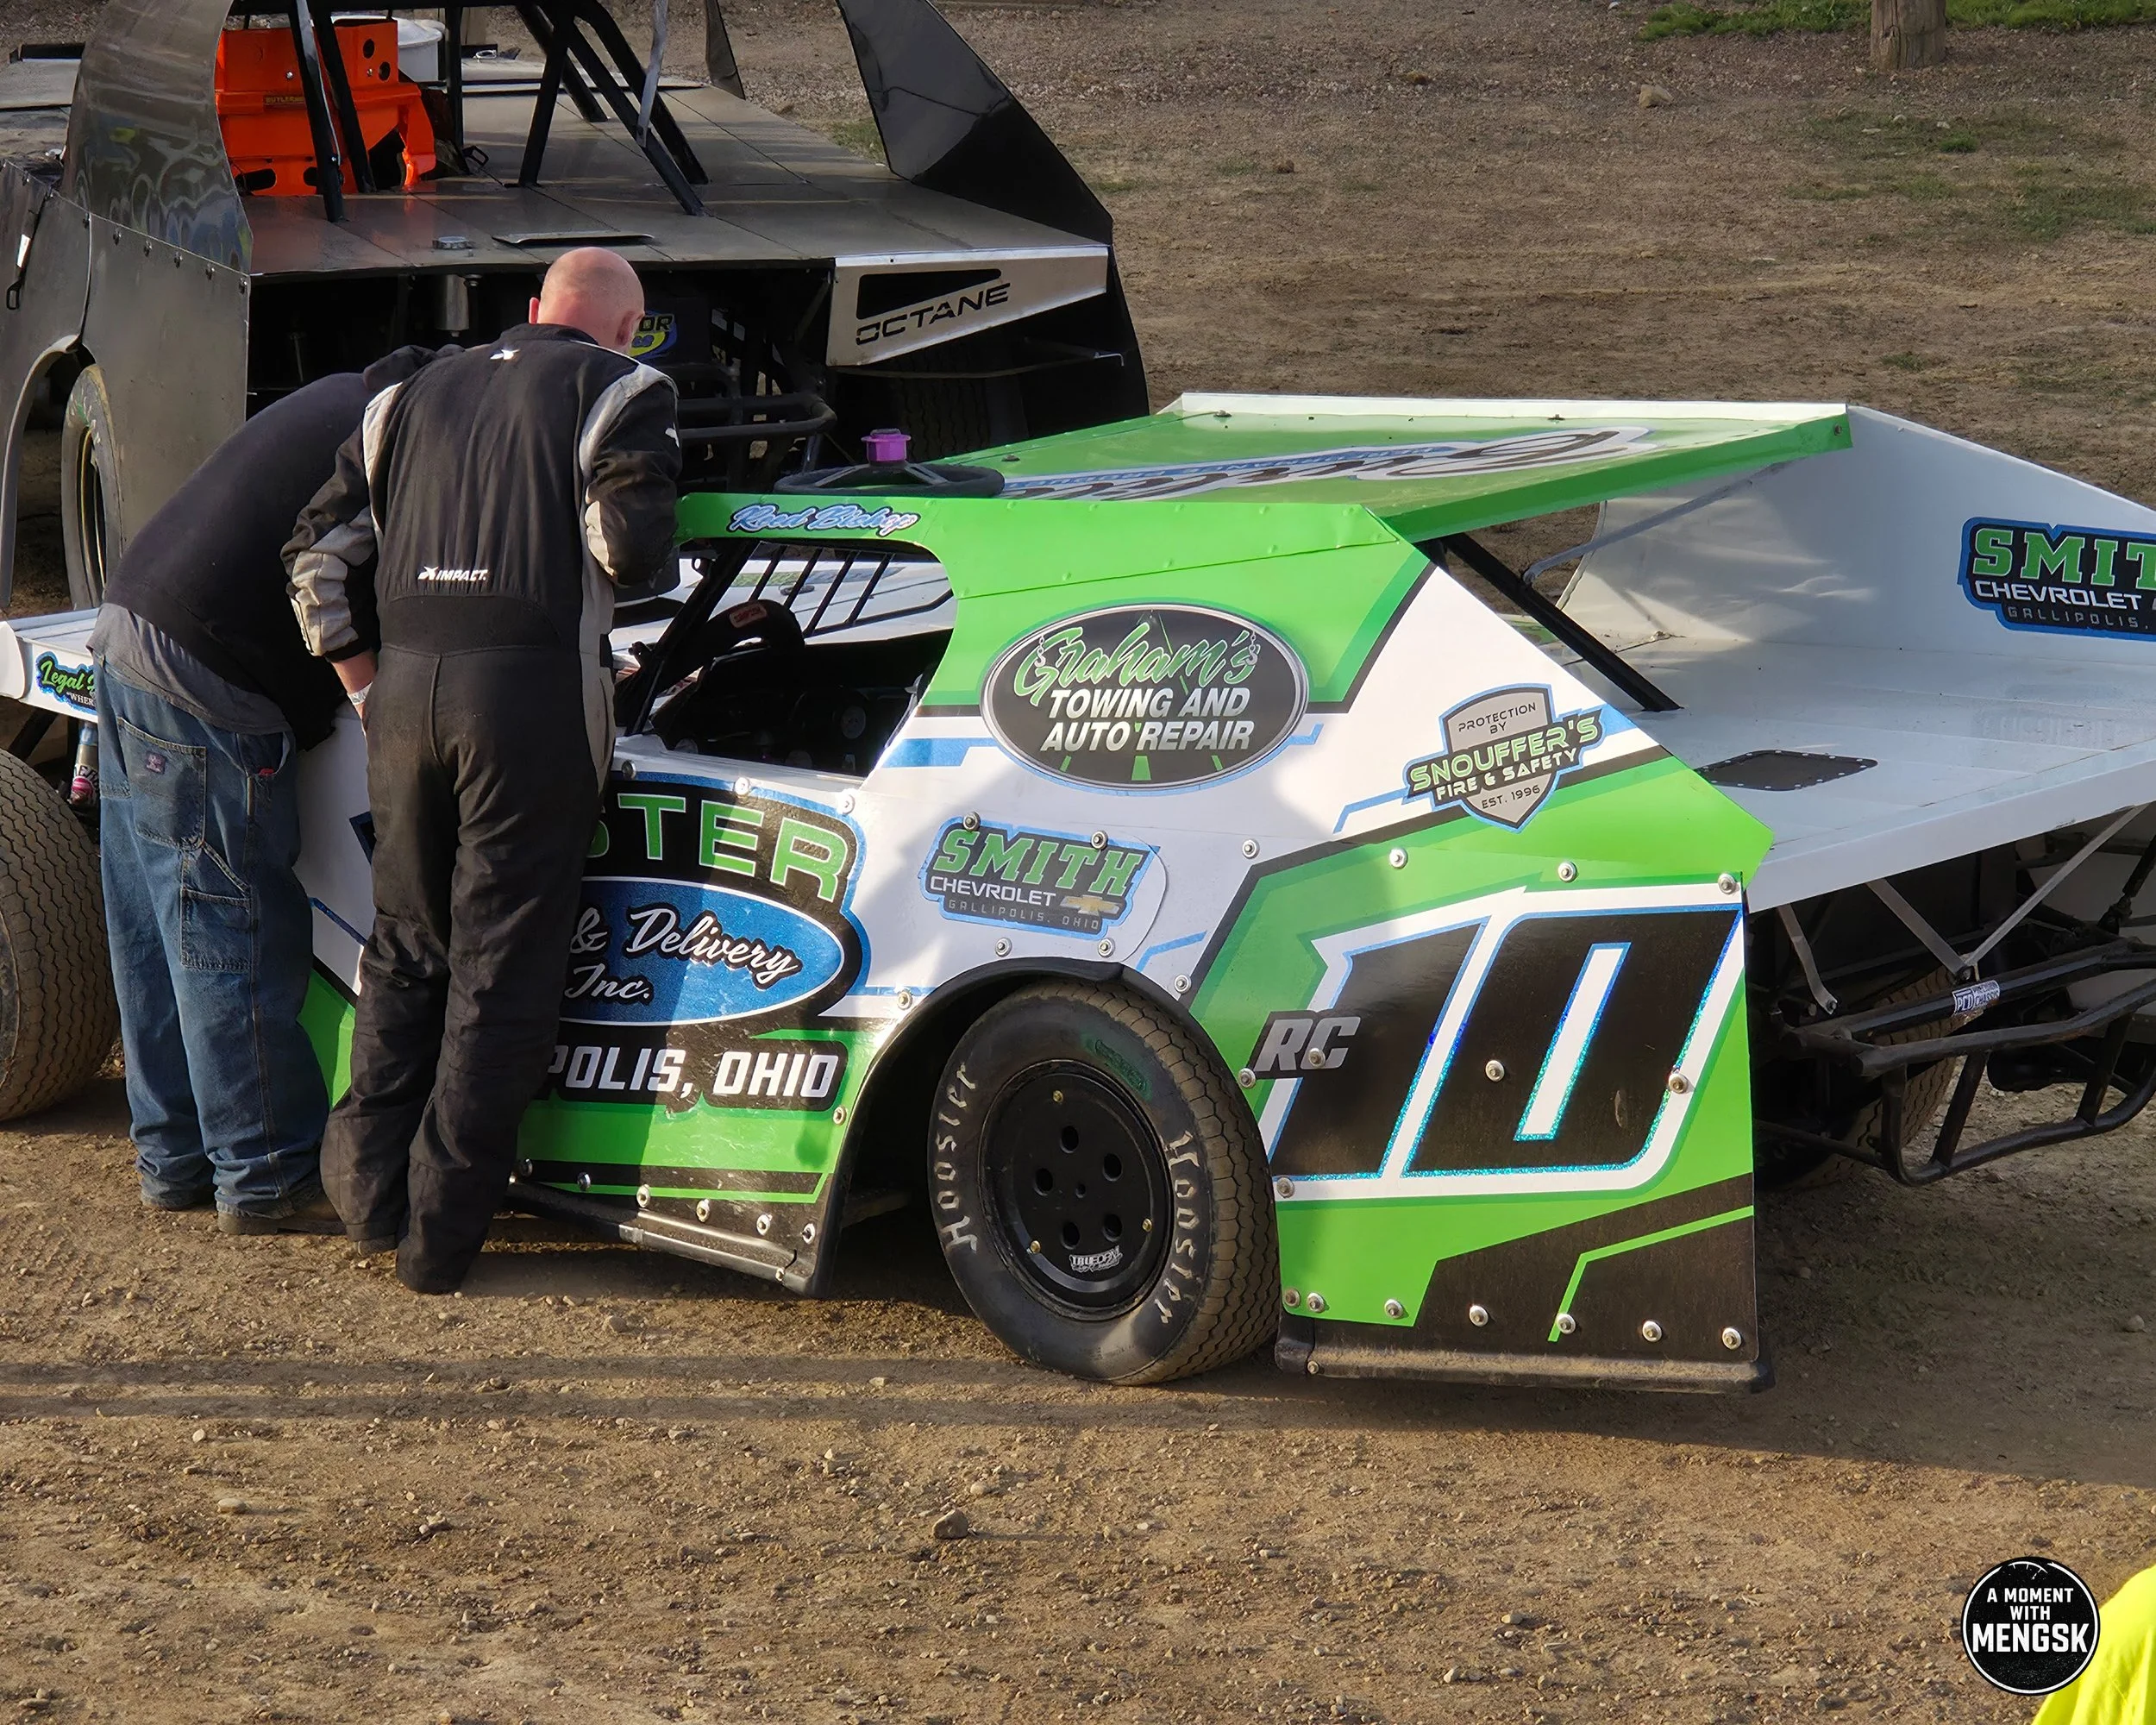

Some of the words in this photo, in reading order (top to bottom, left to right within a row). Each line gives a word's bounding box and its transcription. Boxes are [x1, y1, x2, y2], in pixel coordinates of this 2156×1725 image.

[856, 282, 1011, 345] OCTANE
[1975, 580, 2142, 611] CHEVROLET
[2008, 606, 2149, 630] GALLIPOLIS,
[41, 660, 85, 693] Legal
[1014, 622, 1261, 706] Graham's
[1048, 688, 1173, 719] TOWING
[1179, 687, 1250, 718] AND
[1457, 702, 1537, 732] PROTECTION
[1039, 721, 1131, 751] AUTO
[1136, 721, 1255, 750] REPAIR
[1490, 722, 1507, 734] BY
[1409, 717, 1598, 792] SNOUFFER'S
[1437, 776, 1478, 800] FIRE
[1484, 772, 1497, 786] &
[1501, 748, 1577, 781] SAFETY
[1482, 794, 1508, 809] EST.
[1511, 784, 1541, 800] 1996
[933, 829, 1144, 896] SMITH
[931, 875, 1056, 906] CHEVROLET
[1062, 915, 1099, 930] OHIO
[570, 907, 608, 954] &
[626, 907, 800, 986] Delivery
[564, 963, 650, 999] Inc.
[1255, 1015, 1361, 1071] RC
[1270, 901, 1744, 1180] 10
[712, 1050, 839, 1098] OHIO
